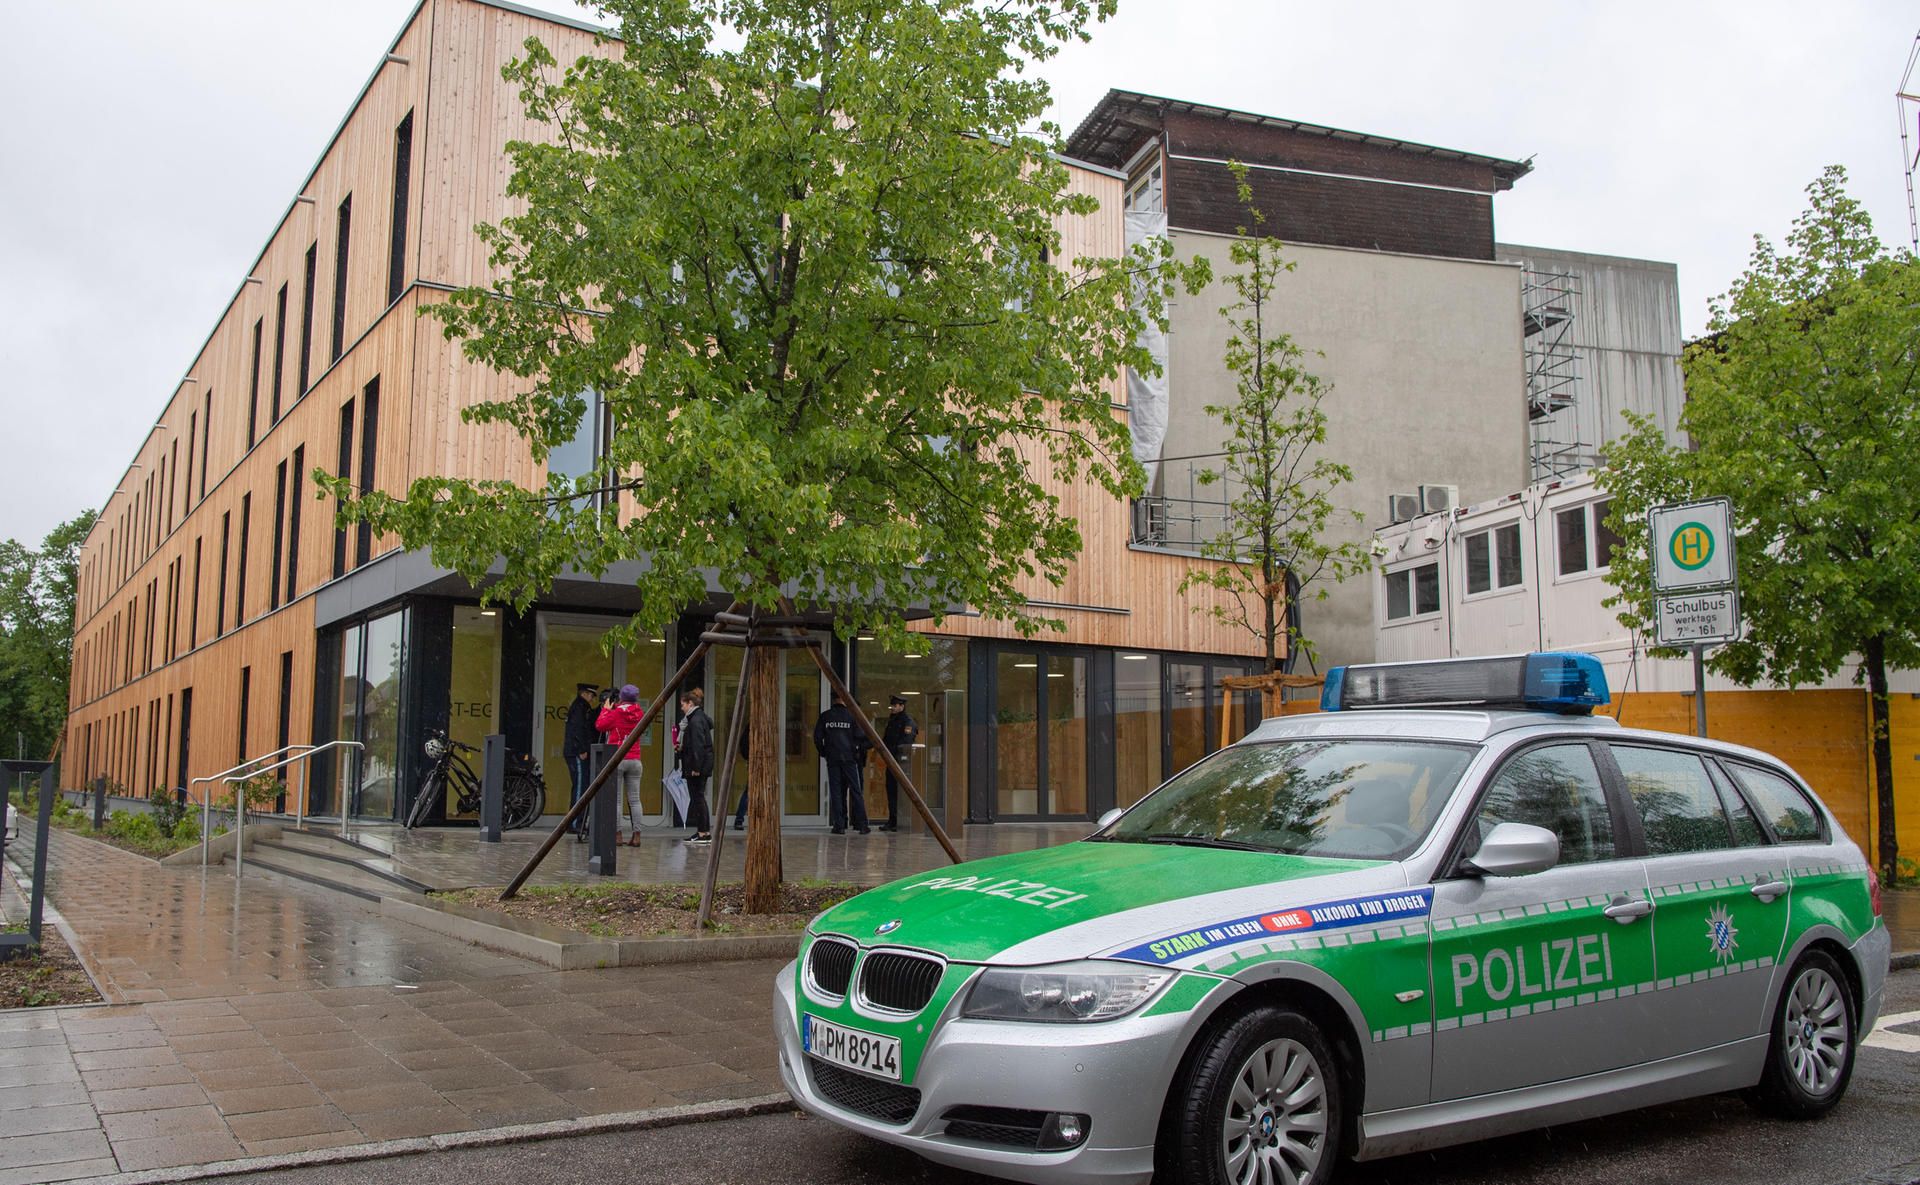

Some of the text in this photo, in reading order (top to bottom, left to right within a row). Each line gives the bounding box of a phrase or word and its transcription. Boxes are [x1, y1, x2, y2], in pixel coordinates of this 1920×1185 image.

[1681, 531, 1702, 561] H
[1665, 599, 1726, 614] Schulbus
[1674, 615, 1717, 624] werktags
[825, 721, 851, 729] POLIZEI
[901, 876, 1089, 909] POLIZEI
[1149, 894, 1427, 959] STARK IM LEBEN OHNE ALKOHOL UND DROGEN
[1451, 932, 1613, 1008] POLIZEI
[810, 1021, 818, 1051] M
